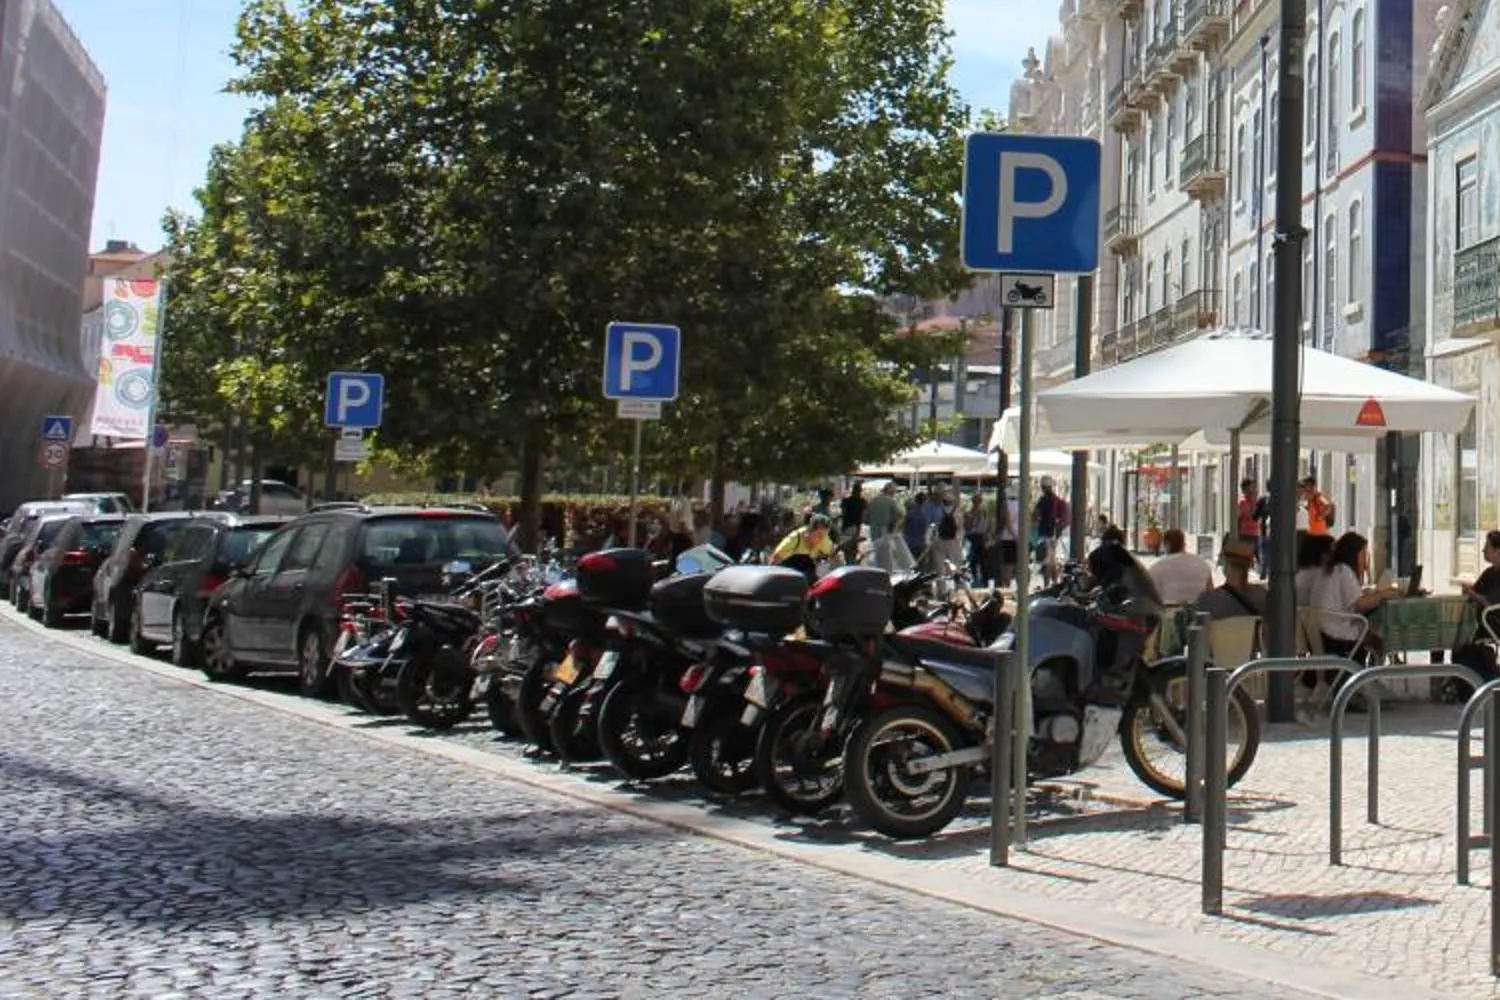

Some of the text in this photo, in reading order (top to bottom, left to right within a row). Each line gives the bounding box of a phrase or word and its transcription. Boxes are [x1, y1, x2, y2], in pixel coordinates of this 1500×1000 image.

[997, 151, 1069, 254] P
[619, 331, 664, 392] P
[337, 378, 371, 422] P
